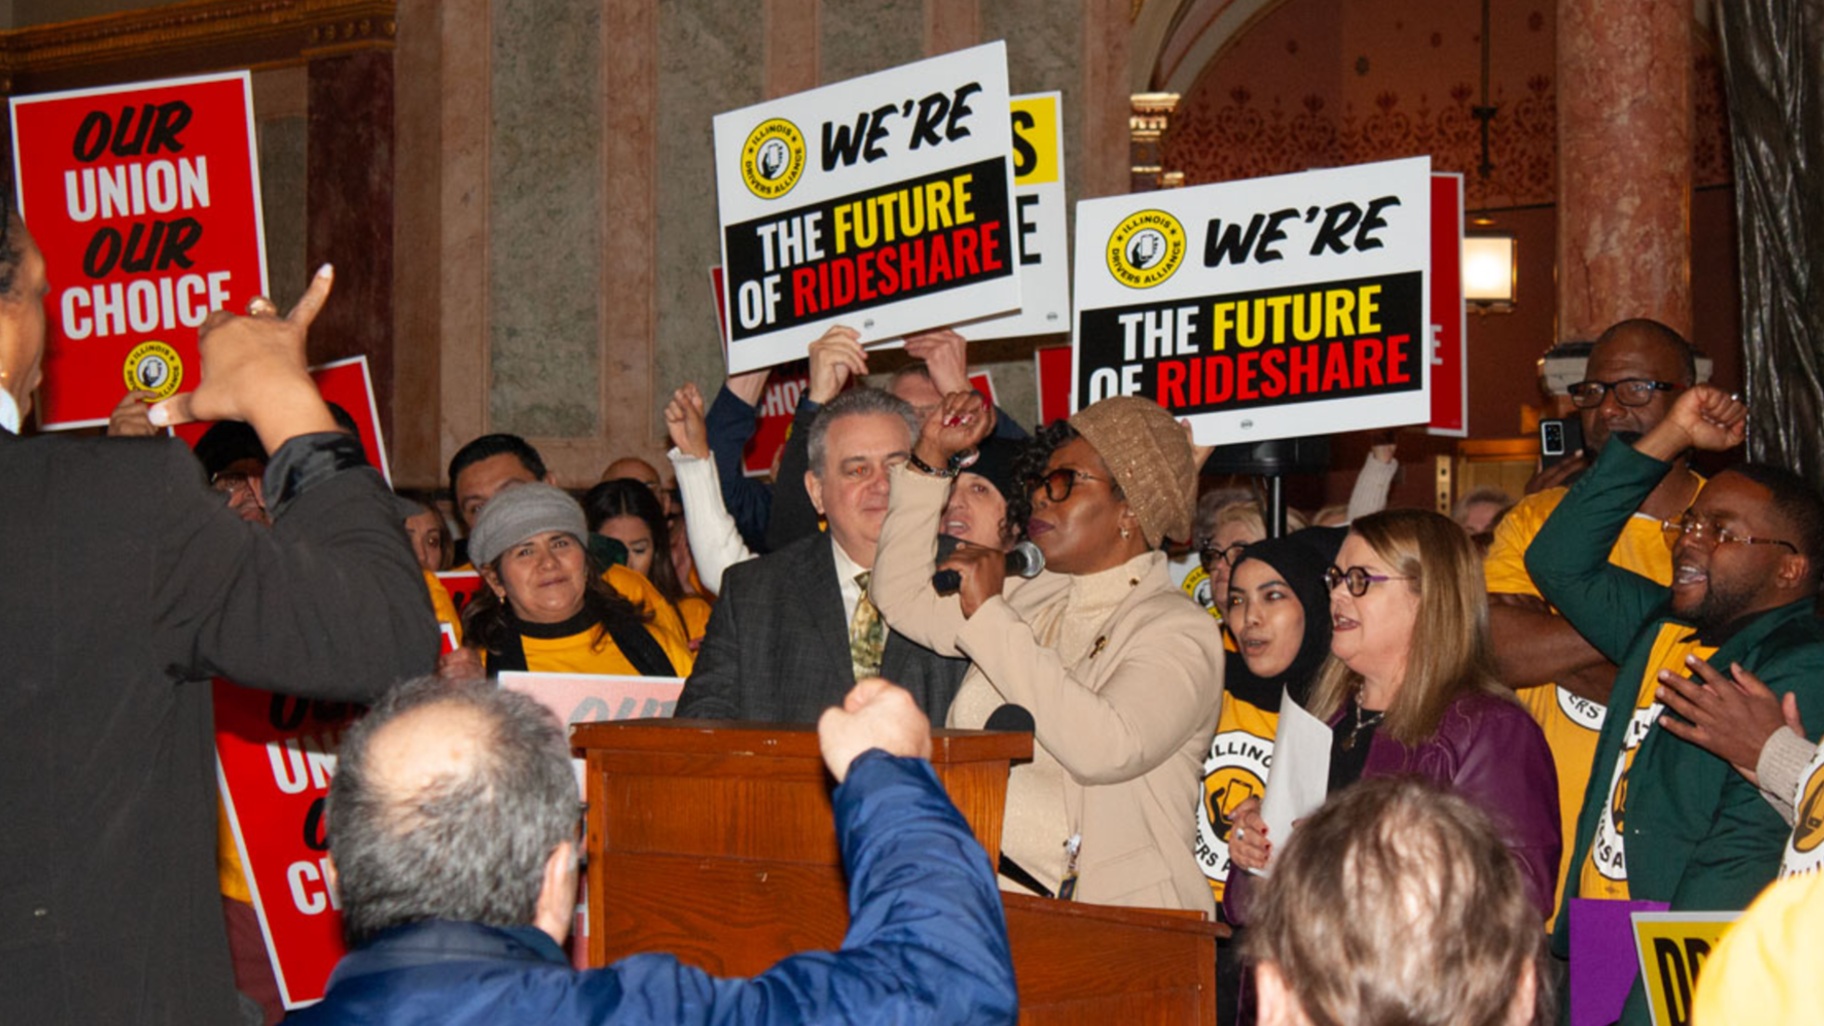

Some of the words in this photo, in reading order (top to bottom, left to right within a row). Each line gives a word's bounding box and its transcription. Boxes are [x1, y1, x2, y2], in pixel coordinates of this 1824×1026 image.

[73, 100, 193, 163] OUR
[752, 125, 792, 146] ILLINOIS
[821, 82, 982, 172] WE'RE
[65, 155, 210, 222] UNION
[745, 160, 772, 194] DRIVERS
[774, 148, 803, 194] ALLIANCE
[83, 216, 203, 279] OUR
[756, 211, 825, 272] THE
[834, 173, 975, 254] FUTURE
[1122, 215, 1172, 234] ILLINOIS
[1203, 195, 1401, 268] WE'RE
[738, 274, 781, 330] OF
[793, 221, 1002, 317] RIDESHARE
[1111, 247, 1141, 284] DRIVERS
[1143, 240, 1181, 284] ALLIANCE
[61, 270, 231, 340] CHOICE
[1118, 305, 1200, 361] THE
[1213, 284, 1382, 351] FUTURE
[1157, 334, 1410, 410] RIDESHARE
